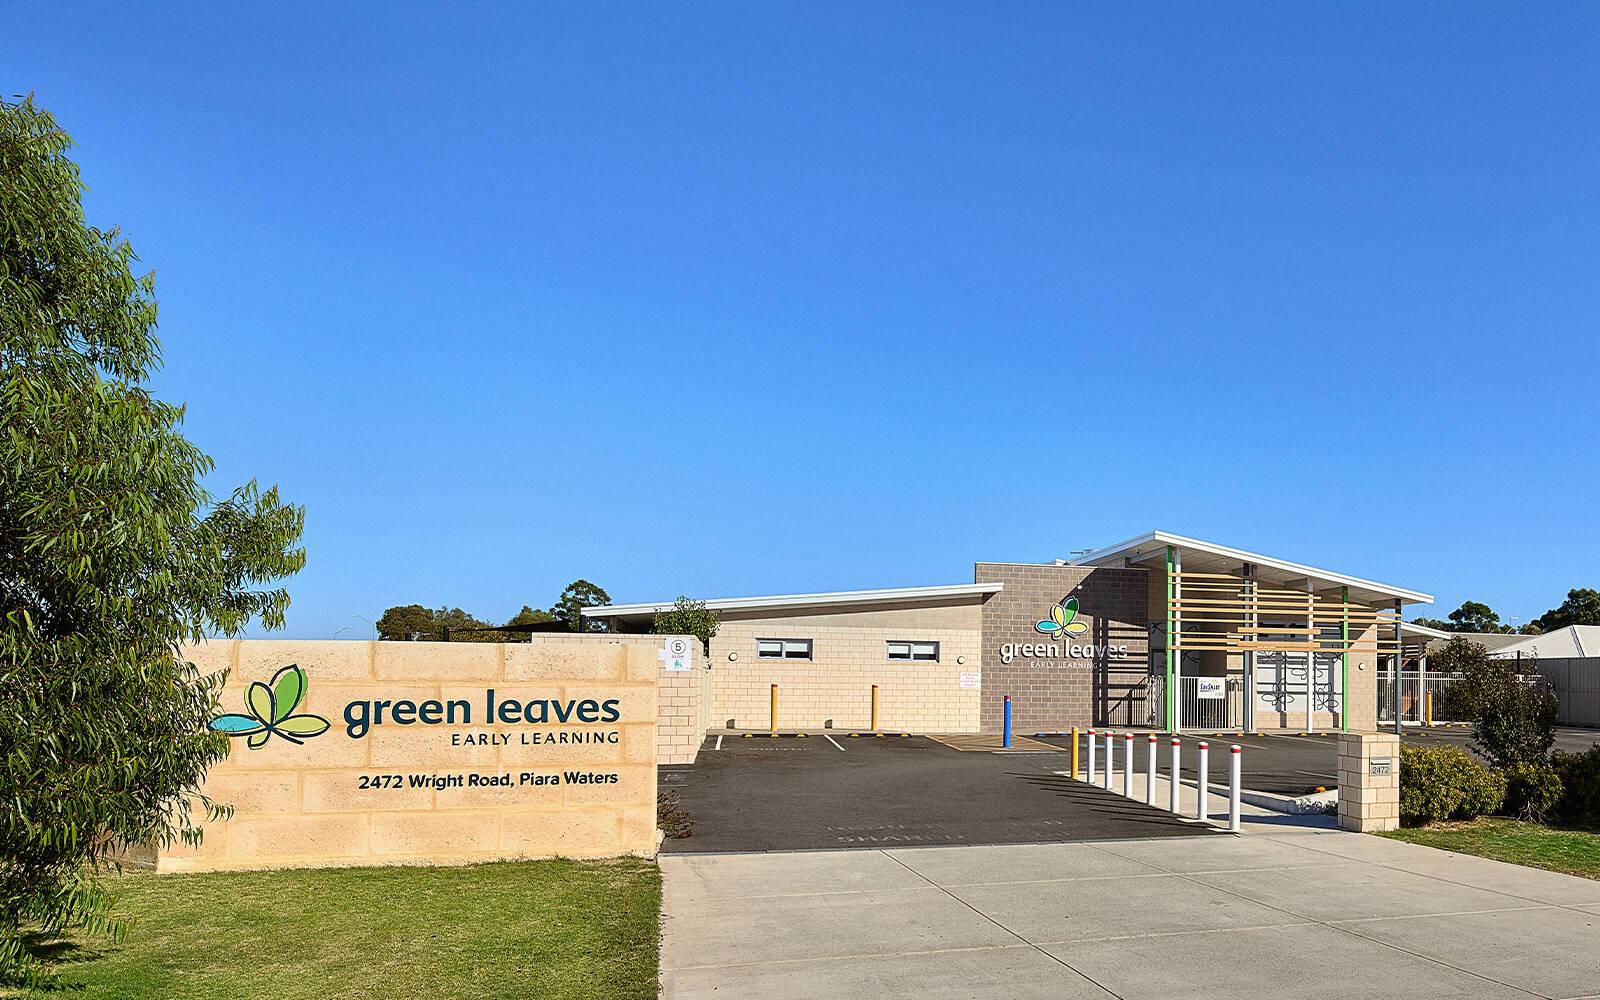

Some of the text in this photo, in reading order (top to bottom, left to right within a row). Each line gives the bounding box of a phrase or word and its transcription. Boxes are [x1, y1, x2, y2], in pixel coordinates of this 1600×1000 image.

[675, 643, 682, 652] 5
[1000, 638, 1128, 663] green leaves
[1030, 661, 1098, 669] EARLY LEARNING
[343, 688, 620, 739] green leaves
[451, 731, 620, 747] EARLY LEARNING
[1372, 766, 1389, 774] 2472
[358, 771, 618, 791] 2472 Wright Road, Piara Waters
